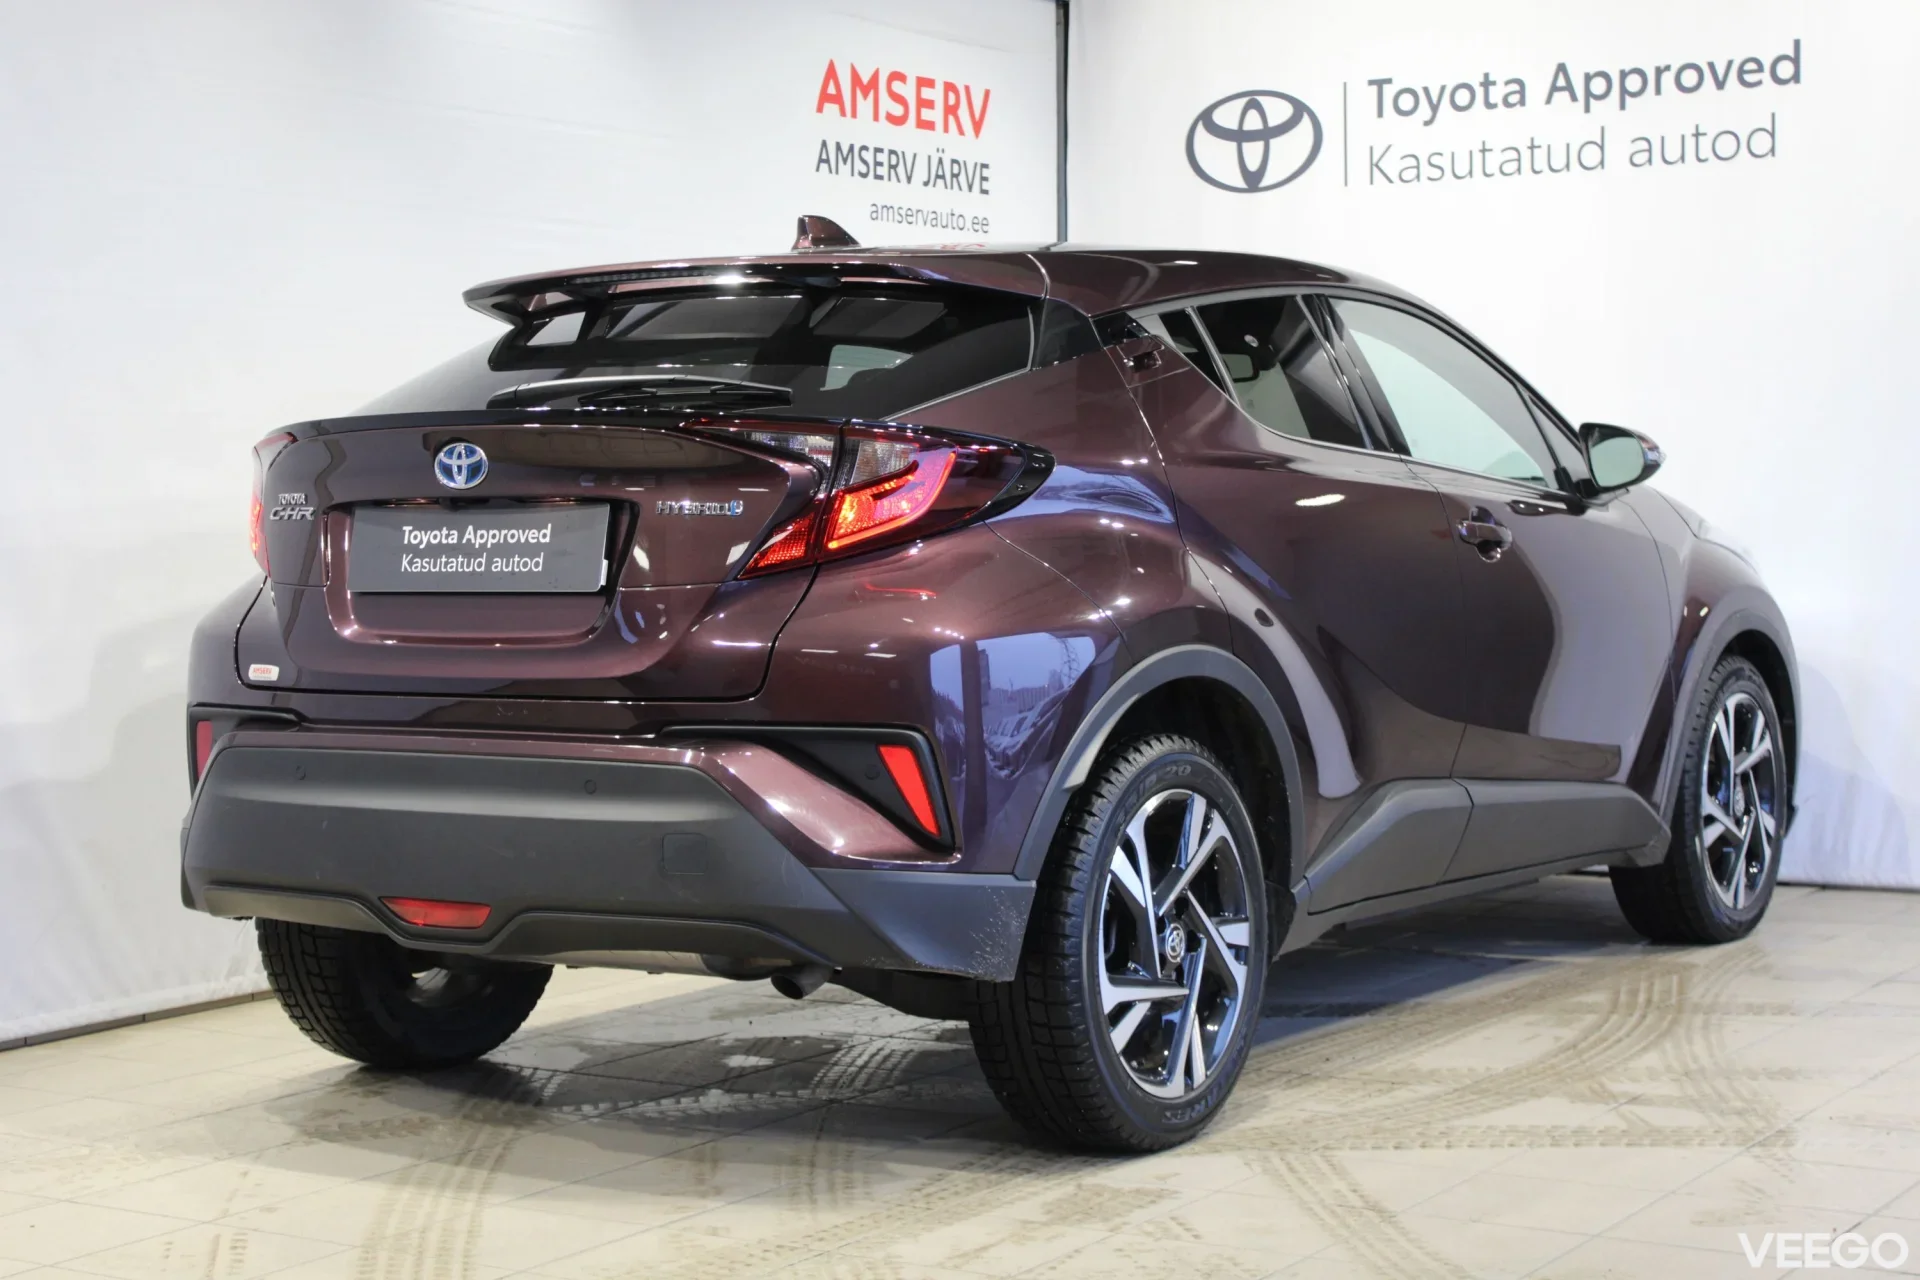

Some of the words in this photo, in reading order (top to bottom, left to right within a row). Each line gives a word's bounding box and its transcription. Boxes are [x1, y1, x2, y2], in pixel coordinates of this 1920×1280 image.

[816, 58, 991, 140] AMSERV
[1367, 71, 1527, 126] Toyota
[1544, 39, 1802, 113] Approved
[815, 139, 917, 185] AMSERV
[922, 148, 990, 196] JÄRVE
[1368, 126, 1606, 186] Kasutatud
[1628, 112, 1777, 168] autod
[869, 203, 990, 234] amservauto.ee
[278, 493, 306, 505] TOYOTA
[402, 525, 458, 549] Toyota
[462, 523, 552, 549] Approved
[401, 552, 487, 573] Kasutatud
[491, 552, 544, 572] autod
